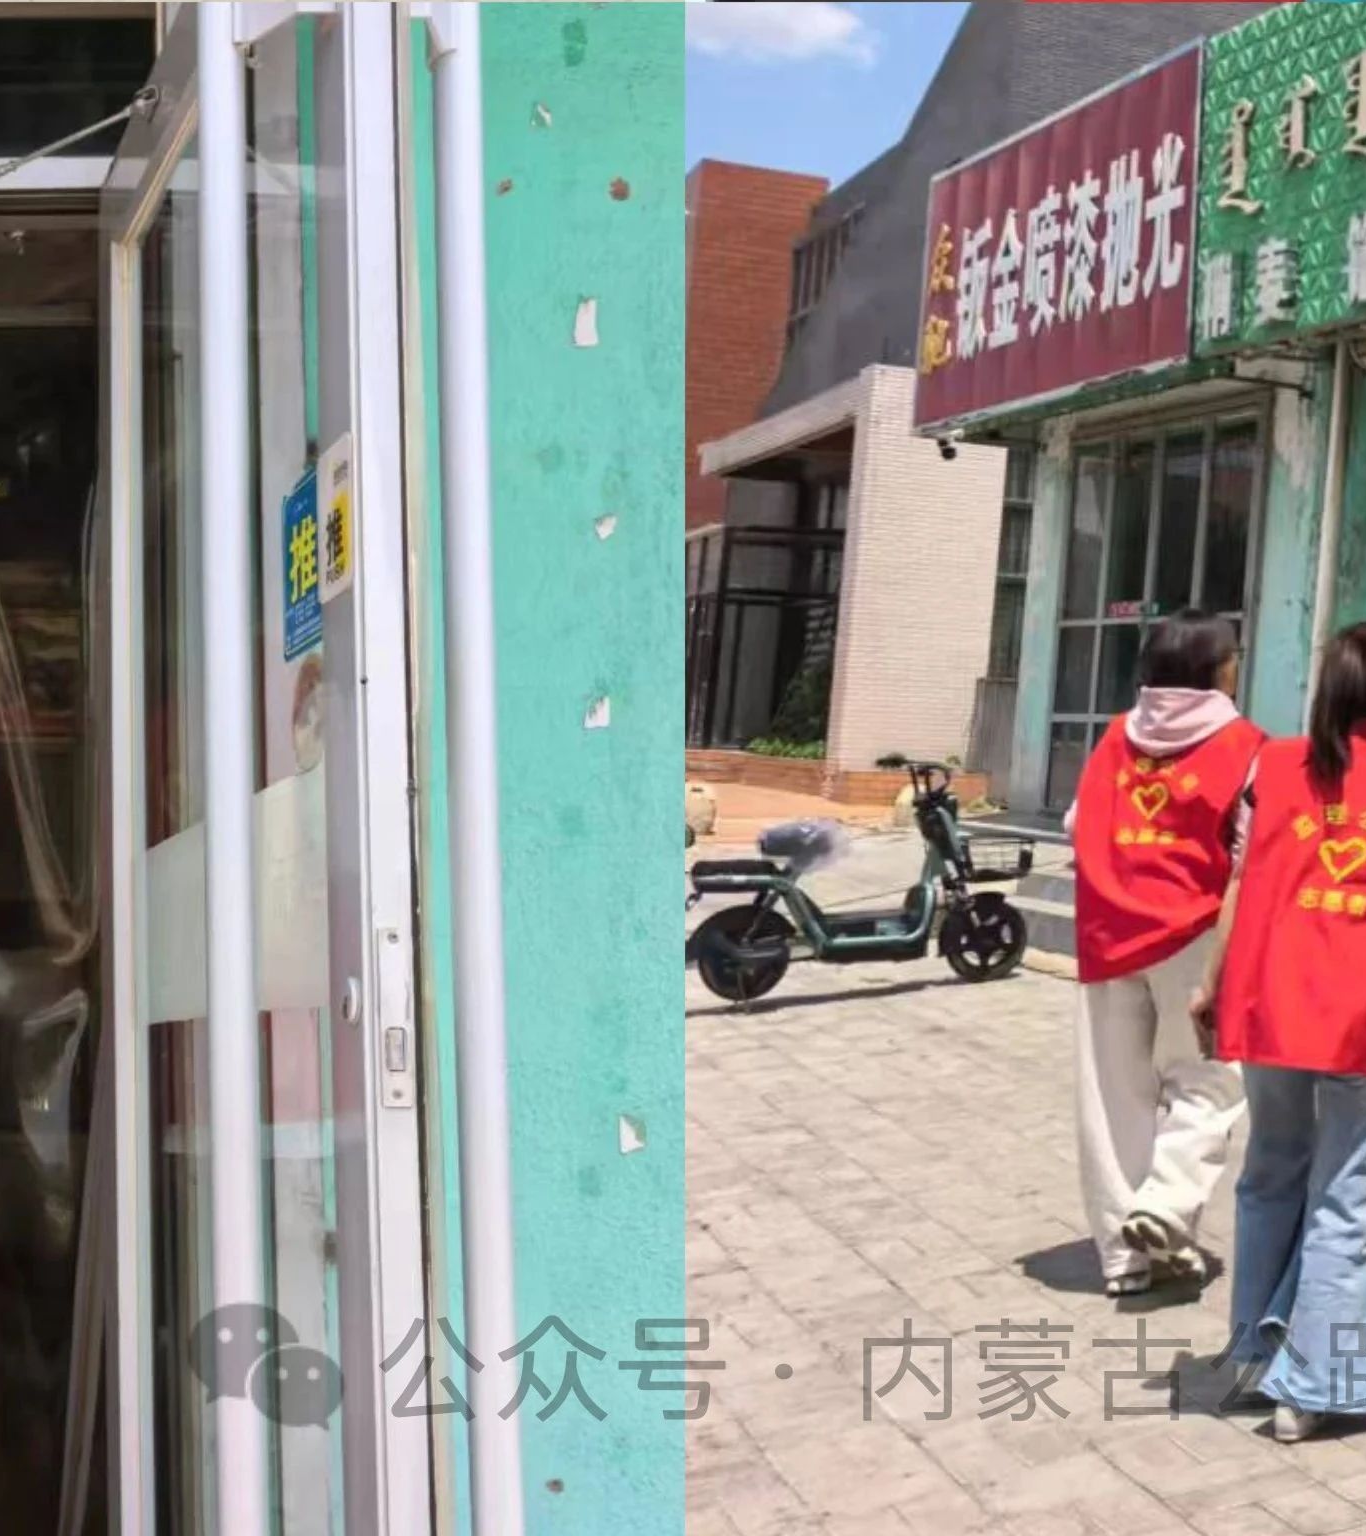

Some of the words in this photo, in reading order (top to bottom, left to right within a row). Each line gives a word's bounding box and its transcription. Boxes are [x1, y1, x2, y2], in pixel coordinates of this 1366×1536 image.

[955, 131, 1186, 361] 钣金喷漆抛光
